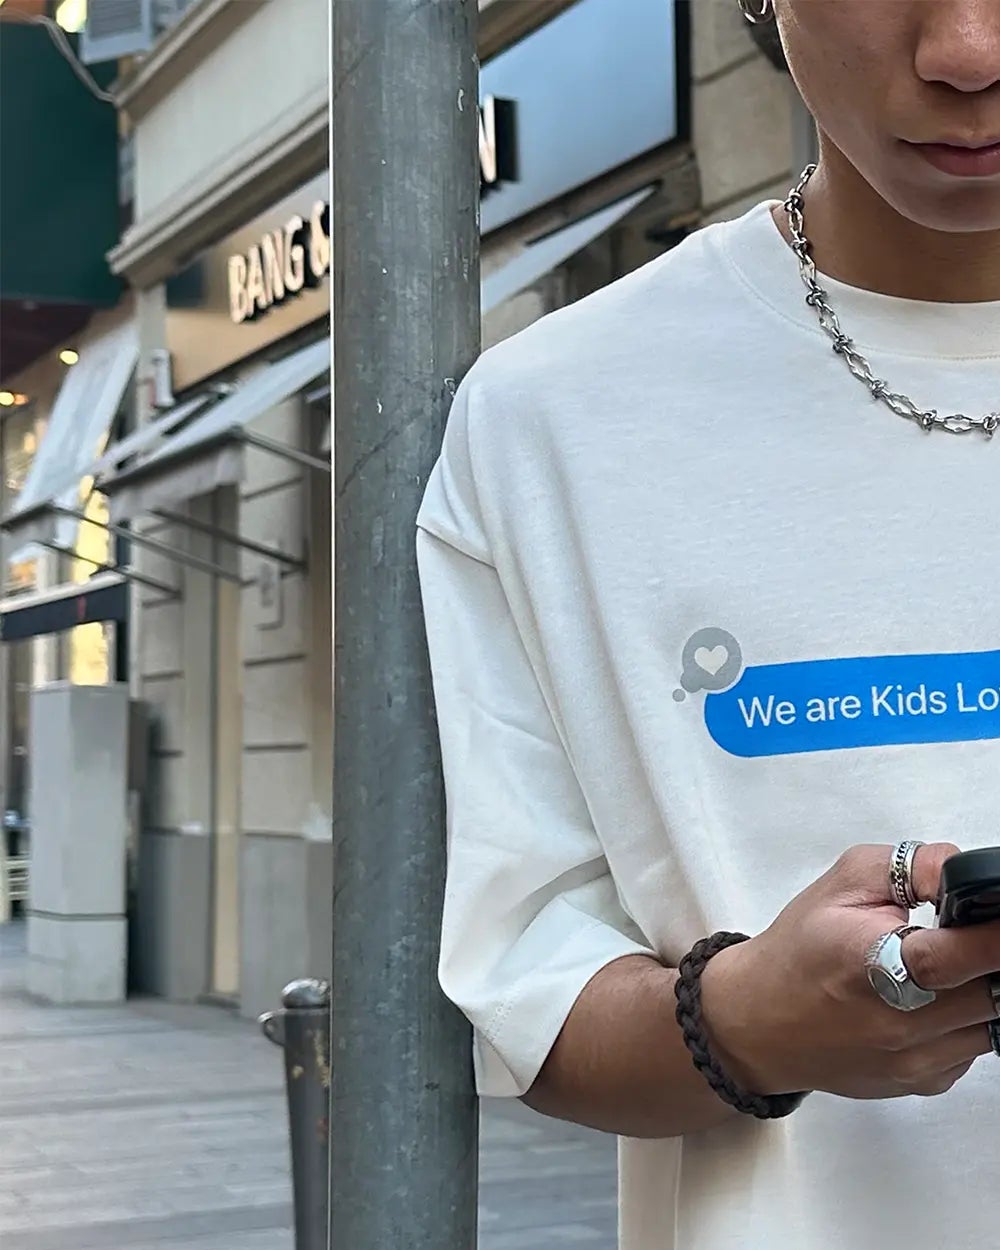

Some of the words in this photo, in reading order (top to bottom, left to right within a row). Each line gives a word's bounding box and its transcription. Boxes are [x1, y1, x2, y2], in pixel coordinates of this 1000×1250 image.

[228, 215, 304, 322] BANG
[738, 695, 796, 728] We
[806, 696, 861, 722] are
[871, 683, 947, 717] Kids
